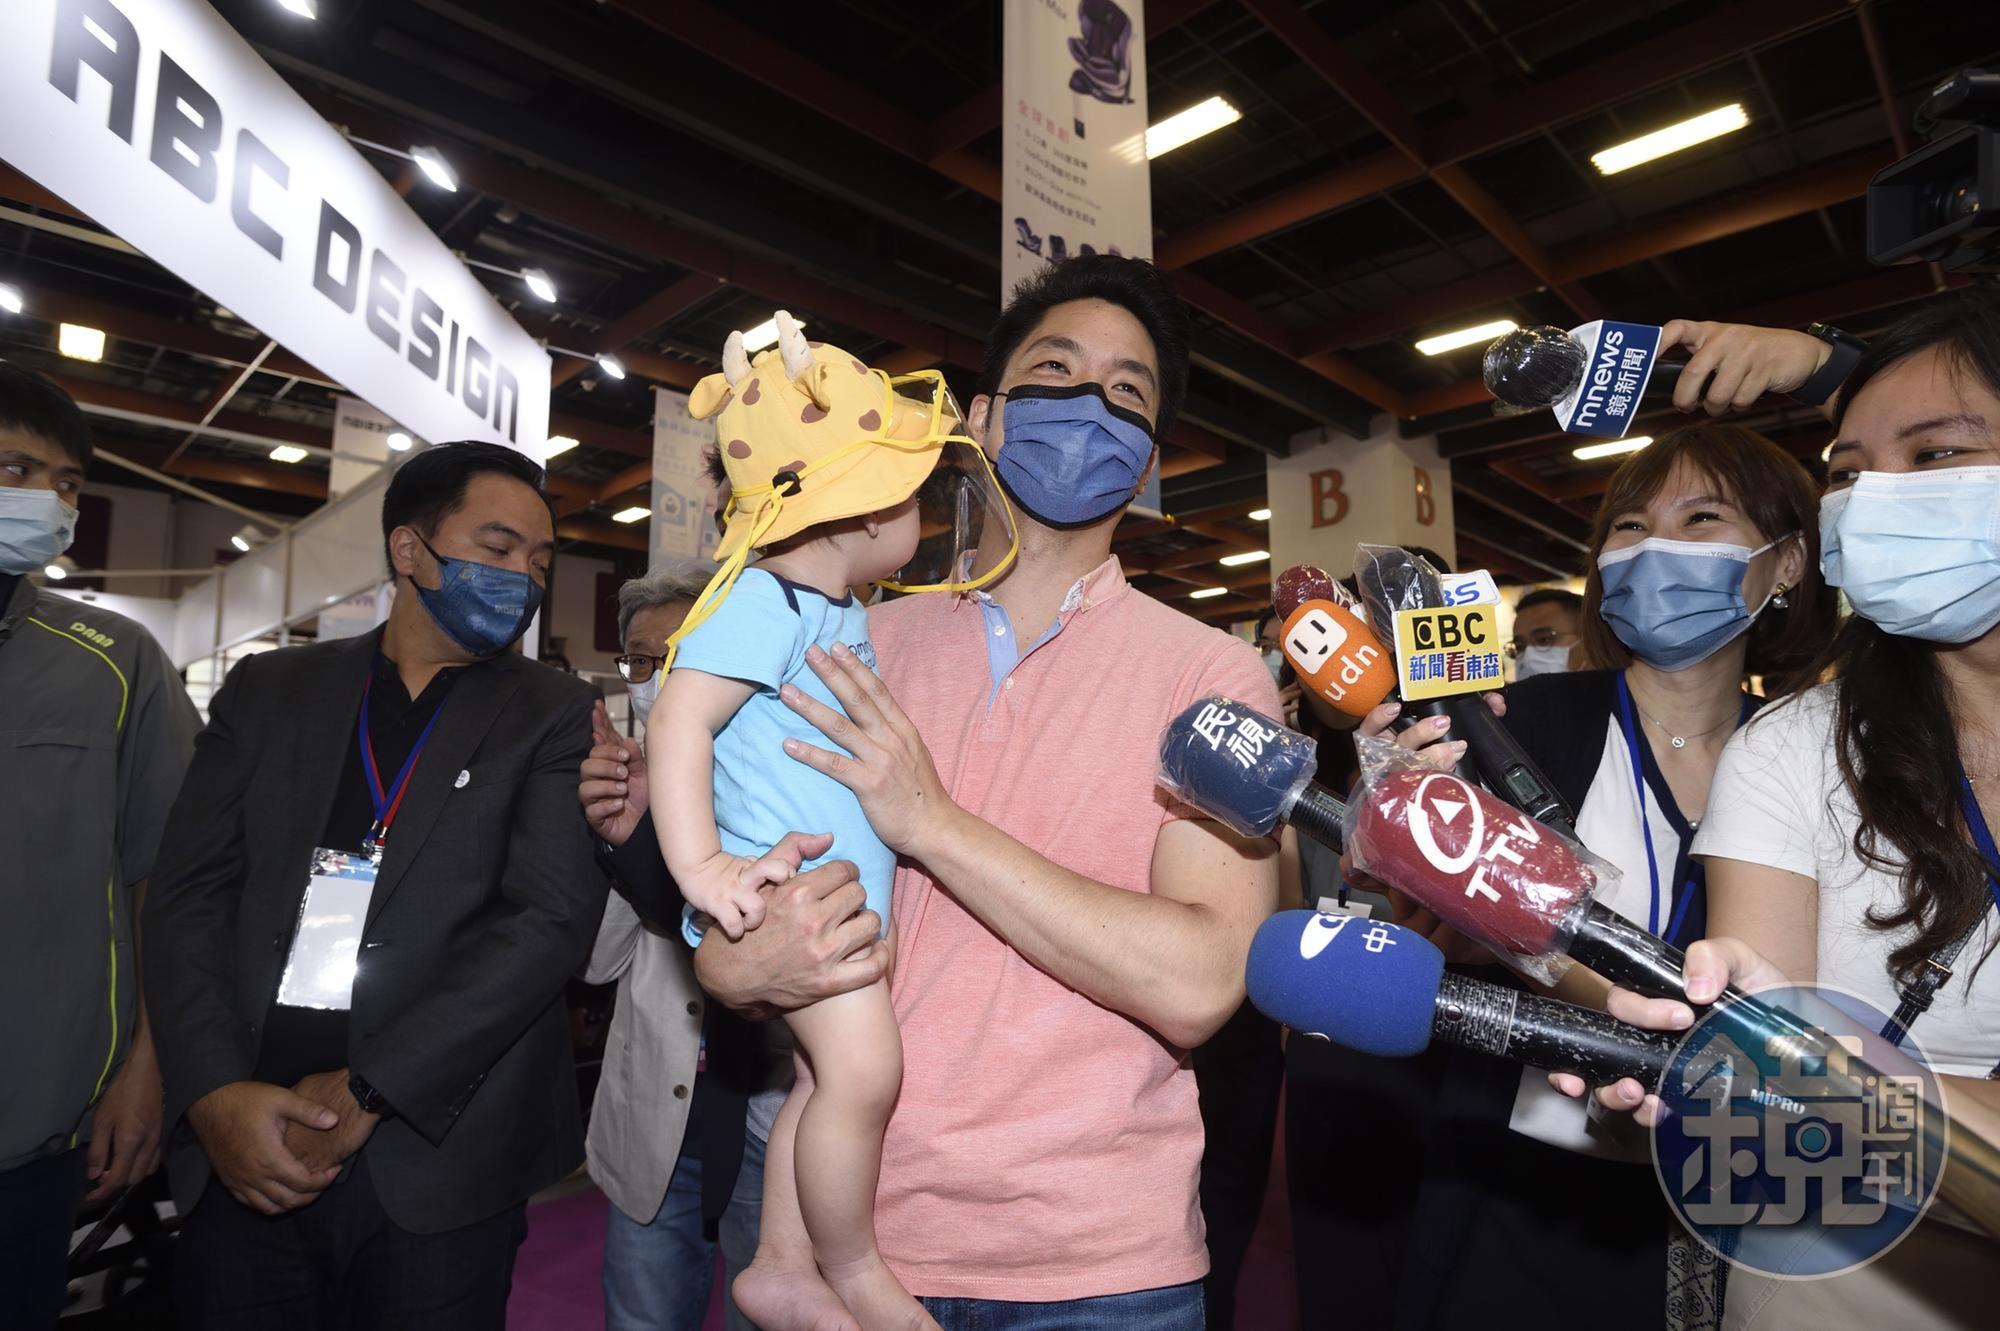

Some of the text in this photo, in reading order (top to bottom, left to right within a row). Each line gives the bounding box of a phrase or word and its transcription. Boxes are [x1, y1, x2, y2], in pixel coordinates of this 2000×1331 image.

[49, 0, 519, 444] ABC DESIGN
[1575, 330, 1624, 427] mnews
[1605, 347, 1648, 417] 鏡新聞
[1309, 469, 1351, 530] B
[1414, 466, 1436, 526] B
[1324, 644, 1380, 701] udn
[1409, 651, 1500, 683] 新聞看東森
[1192, 702, 1276, 769] 民視
[1464, 815, 1541, 904] TTV
[1361, 918, 1400, 953] 中
